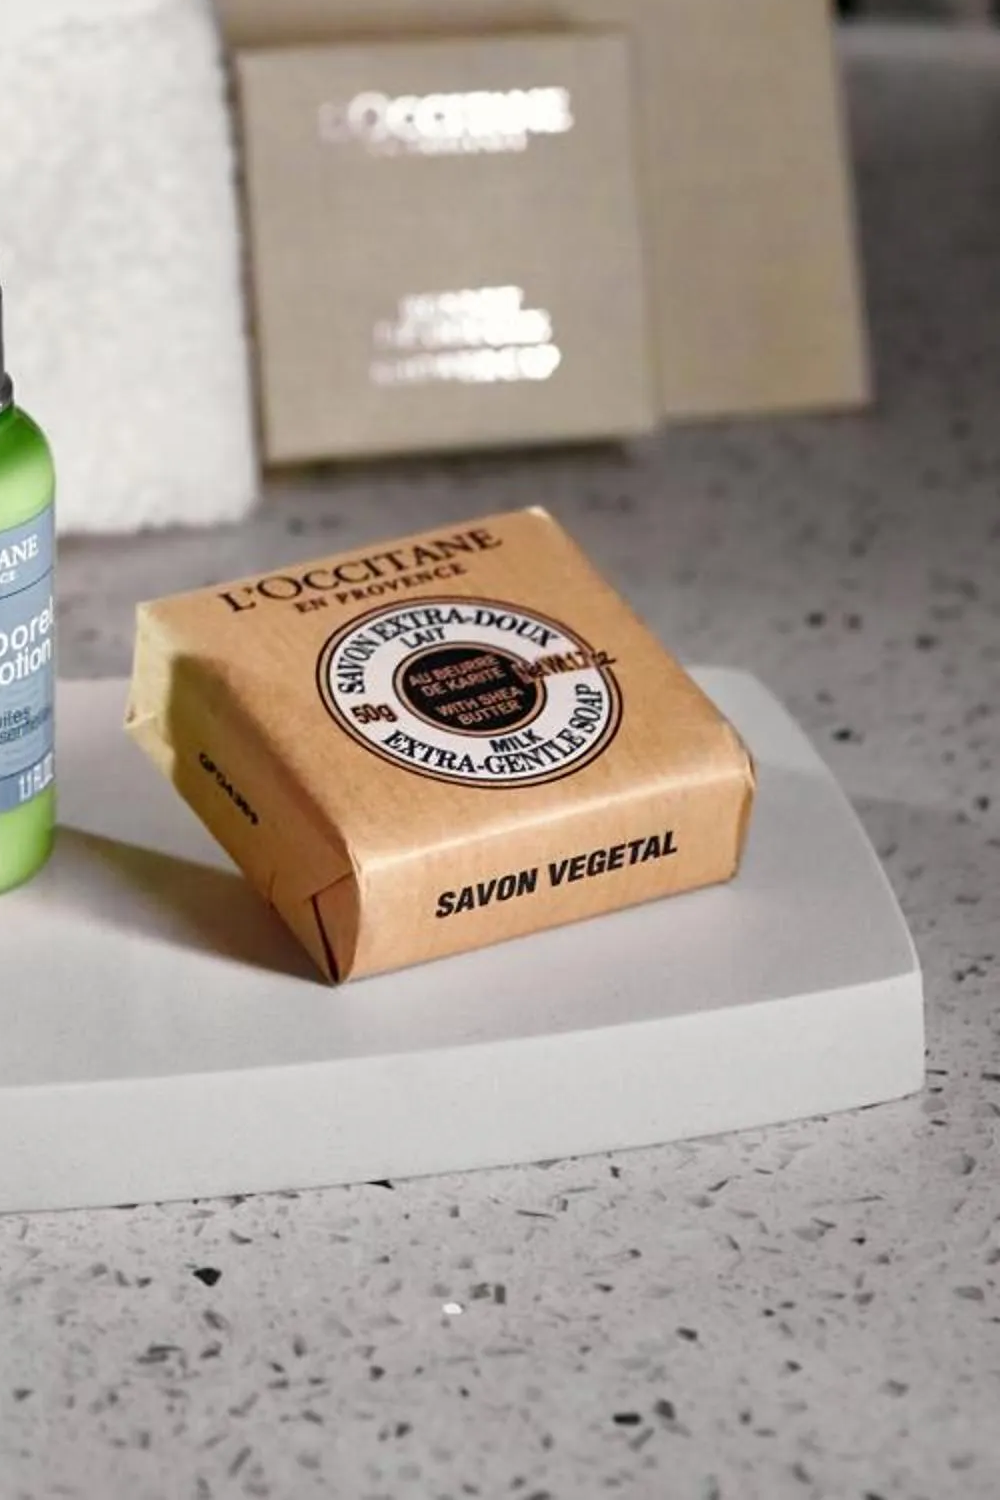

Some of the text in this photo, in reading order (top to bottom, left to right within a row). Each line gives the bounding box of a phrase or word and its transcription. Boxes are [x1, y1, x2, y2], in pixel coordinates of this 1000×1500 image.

[218, 527, 503, 612] L'OCCITANE
[293, 562, 467, 614] EN PROVENCE
[400, 626, 447, 649] LAIT
[338, 607, 561, 695] SAVON EXTRA-DOUX
[408, 671, 433, 688] AU
[420, 682, 448, 697] DE
[350, 703, 398, 725] 50g
[437, 696, 480, 716] WITH
[458, 700, 522, 726] BUTTER
[381, 683, 603, 775] EXTRA-GENTLE SOAP
[489, 729, 544, 753] MILK
[435, 830, 678, 918] SAVON VEGETAL
